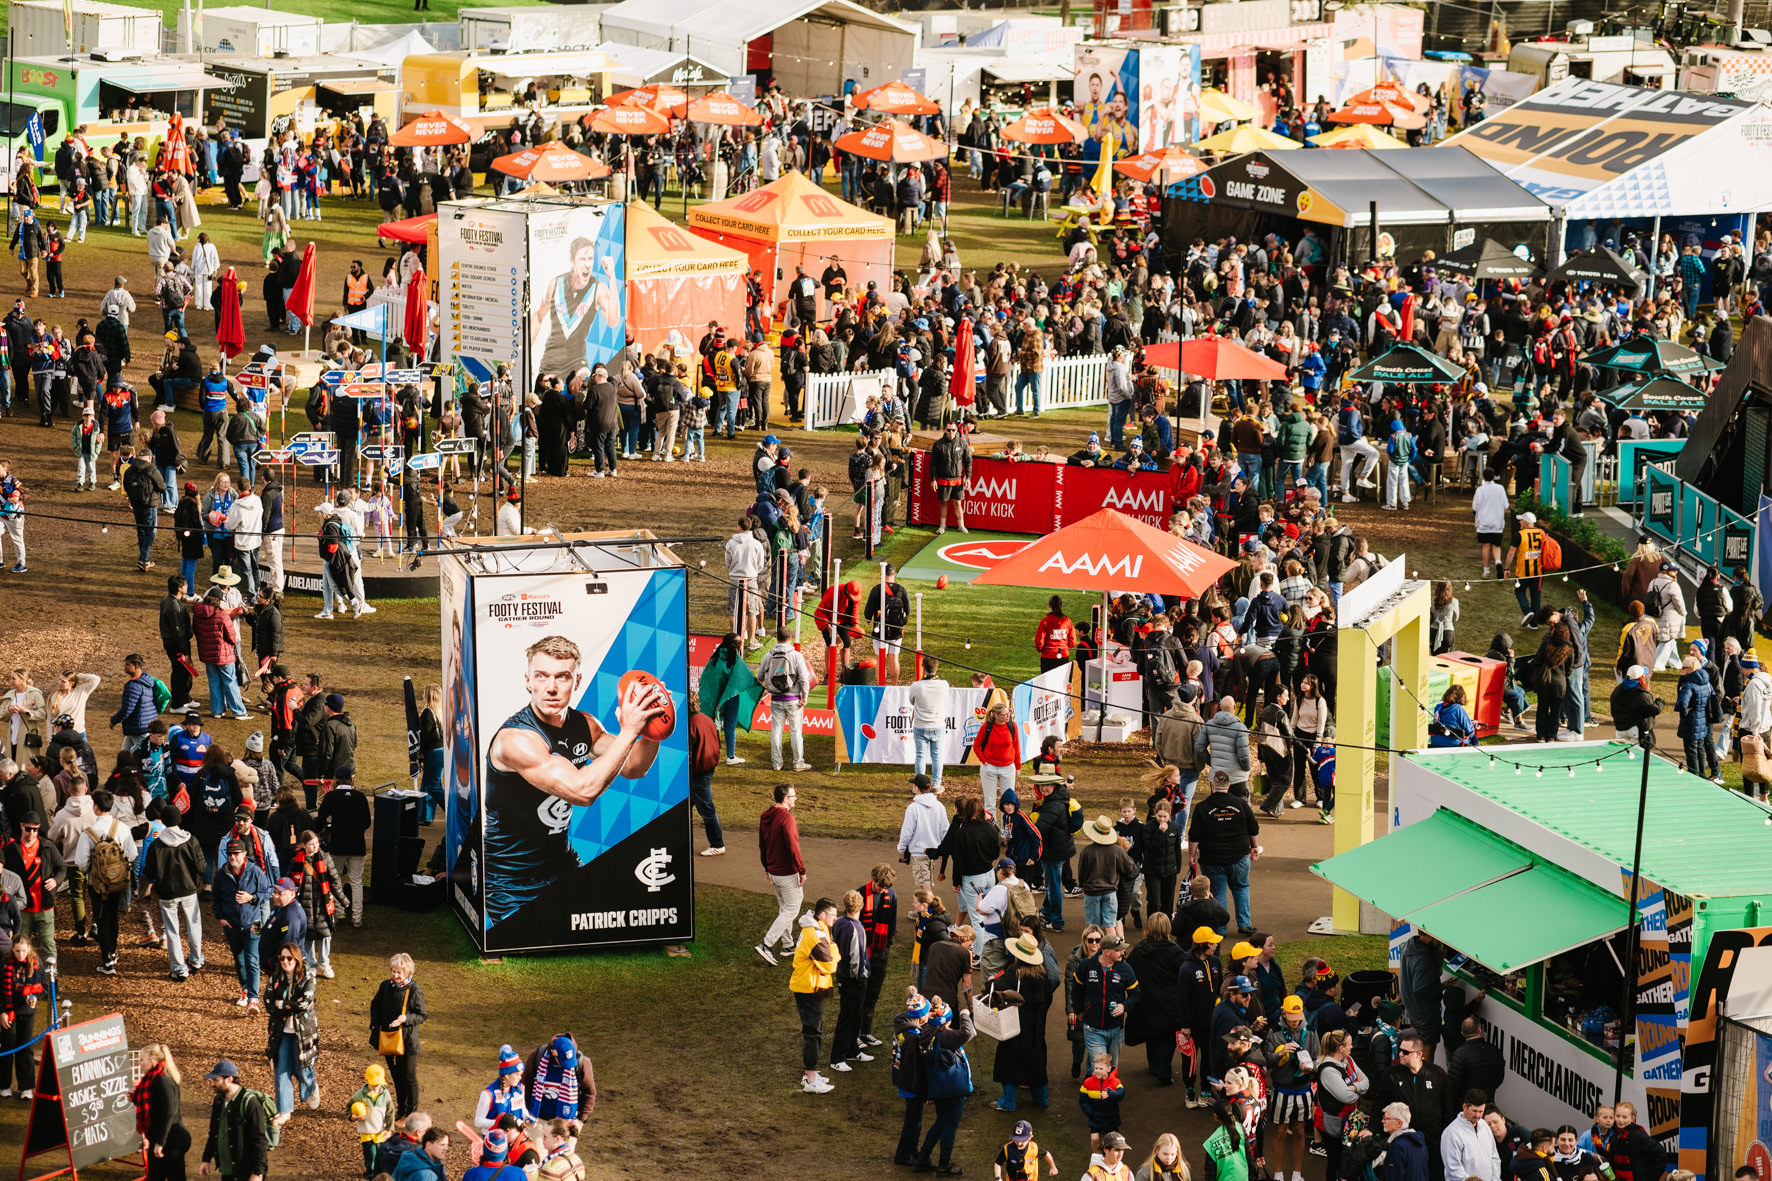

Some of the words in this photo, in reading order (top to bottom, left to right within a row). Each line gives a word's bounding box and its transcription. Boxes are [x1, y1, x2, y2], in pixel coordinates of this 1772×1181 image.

[21, 67, 60, 88] BOOST
[1548, 83, 1749, 117] GATHER
[415, 128, 447, 136] NEVER
[416, 122, 448, 130] NEVER
[1024, 126, 1054, 134] NEVER
[1026, 119, 1055, 127] NEVER
[860, 138, 886, 148] NEVER
[867, 130, 891, 141] NEVER
[1467, 122, 1696, 174] ROUND
[1226, 181, 1255, 200] GAME
[1256, 185, 1286, 205] ZONE
[695, 214, 719, 226] COLLECT
[720, 217, 737, 229] YOUR
[737, 220, 754, 233] CARD
[754, 223, 771, 235] HERE
[787, 226, 820, 237] COLLECT
[821, 227, 843, 237] YOUR
[845, 226, 866, 236] CARD
[867, 225, 886, 235] HERE
[460, 228, 478, 241] FOOTY
[478, 230, 503, 244] FESTIVAL
[674, 263, 696, 272] YOUR
[697, 262, 719, 271] CARD
[719, 261, 739, 270] HERE
[717, 353, 727, 366] 18
[1373, 365, 1407, 373] South
[1056, 466, 1064, 485] AAMI
[963, 476, 1017, 500] AAMI
[1055, 490, 1063, 509] AAMI
[1101, 486, 1164, 512] AAMI
[912, 503, 920, 521] AAMI
[963, 501, 989, 516] UCKY
[990, 503, 1015, 519] KICK
[1527, 532, 1541, 550] 15
[1037, 550, 1143, 578] AAMI
[1163, 541, 1207, 577] AAMI
[288, 575, 324, 592] ADELAIDE
[488, 603, 519, 617] FOOTY
[522, 601, 563, 616] FESTIVAL
[886, 716, 914, 729] FOOTY
[571, 913, 626, 931] PATRICK
[629, 907, 678, 927] CRIPPS
[1637, 1020, 1679, 1055] ROUND
[71, 1055, 116, 1085] BUNNINGS
[1509, 1035, 1604, 1120] MERCHANDISE
[1643, 1058, 1682, 1080] GATHER
[100, 1075, 129, 1098] SIZZLE
[84, 1121, 108, 1146] HATS
